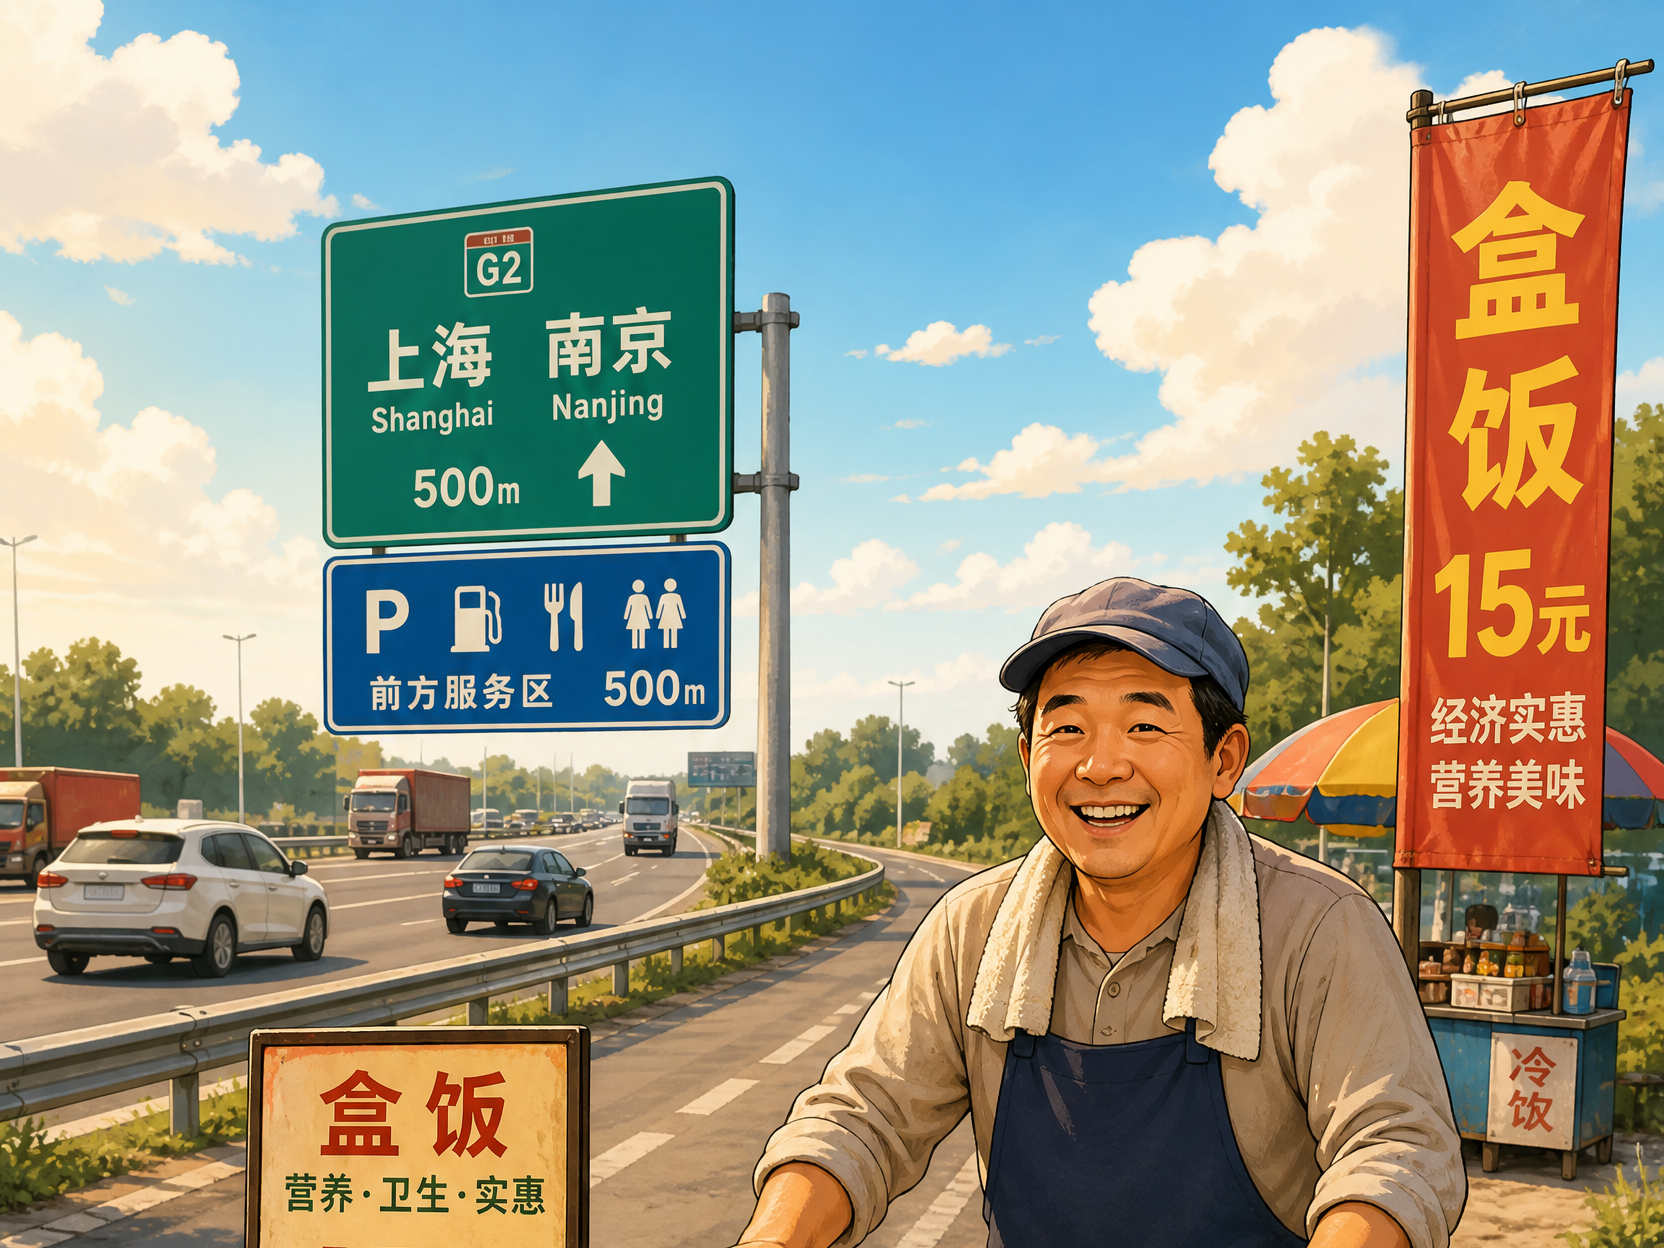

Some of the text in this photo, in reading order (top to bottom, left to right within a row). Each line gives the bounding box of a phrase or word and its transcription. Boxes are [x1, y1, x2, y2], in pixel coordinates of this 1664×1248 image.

[476, 250, 522, 287] G2
[367, 306, 673, 393] 上海 南京
[1448, 181, 1586, 512] 盒饭
[371, 389, 664, 436] Shanghai Nanjing
[413, 465, 520, 508] 500m
[366, 589, 410, 654] P
[1434, 548, 1591, 659] 15元
[369, 669, 705, 711] 前方服务区 500m
[1430, 690, 1587, 746] 经济实惠
[1430, 758, 1586, 811] 营养美味
[319, 1069, 508, 1158] 盒饭
